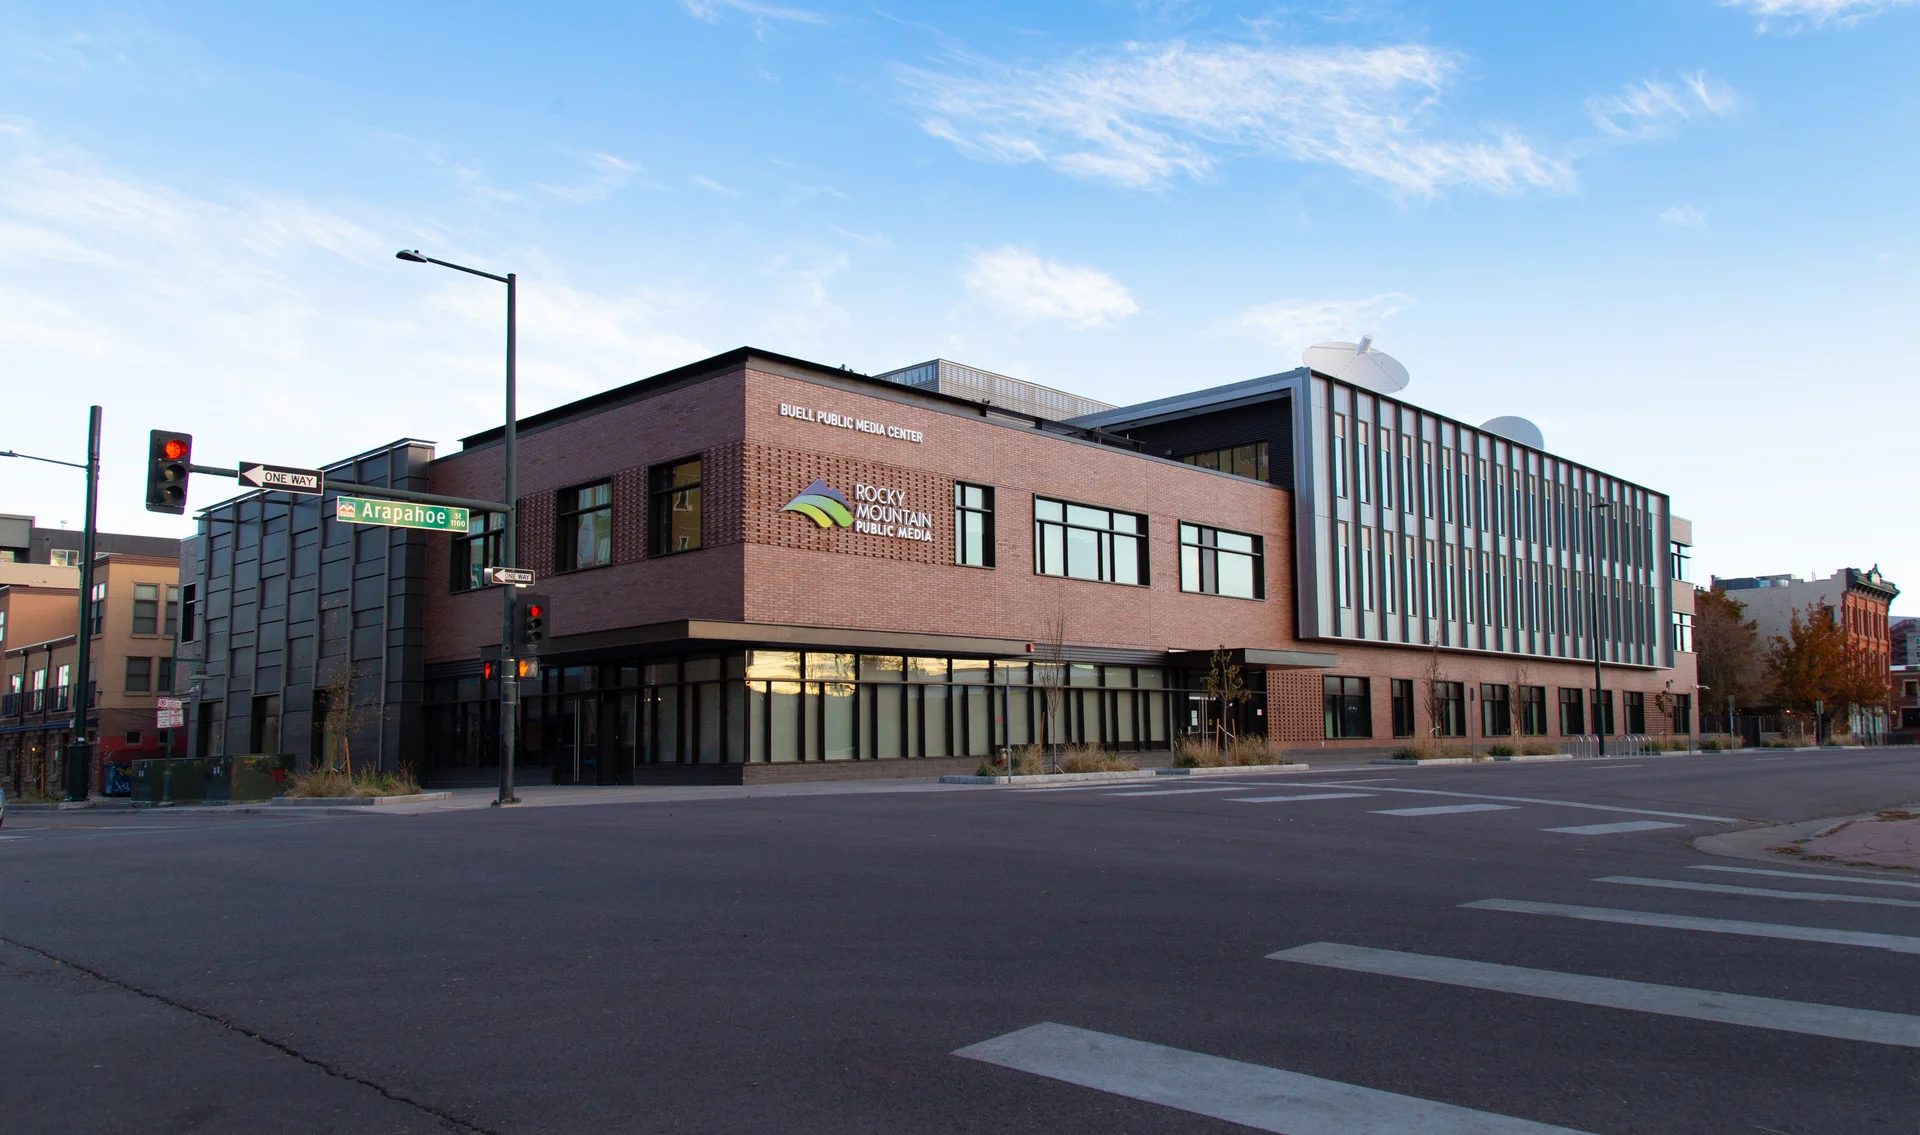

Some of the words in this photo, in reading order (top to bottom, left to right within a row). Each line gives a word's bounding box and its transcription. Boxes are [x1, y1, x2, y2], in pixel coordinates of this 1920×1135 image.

[780, 403, 815, 422] BUELL
[817, 411, 854, 429] PUBLIC
[855, 419, 886, 436] MEDIA
[888, 426, 923, 443] CENTER
[265, 472, 287, 483] ONE
[291, 475, 313, 486] WAY
[855, 483, 906, 507] ROCKY
[362, 502, 446, 524] Arapahoe
[450, 519, 466, 527] 1100
[855, 504, 932, 528] MOUNTAIN
[855, 521, 894, 537] PUBLIC
[897, 526, 932, 542] MEDIA
